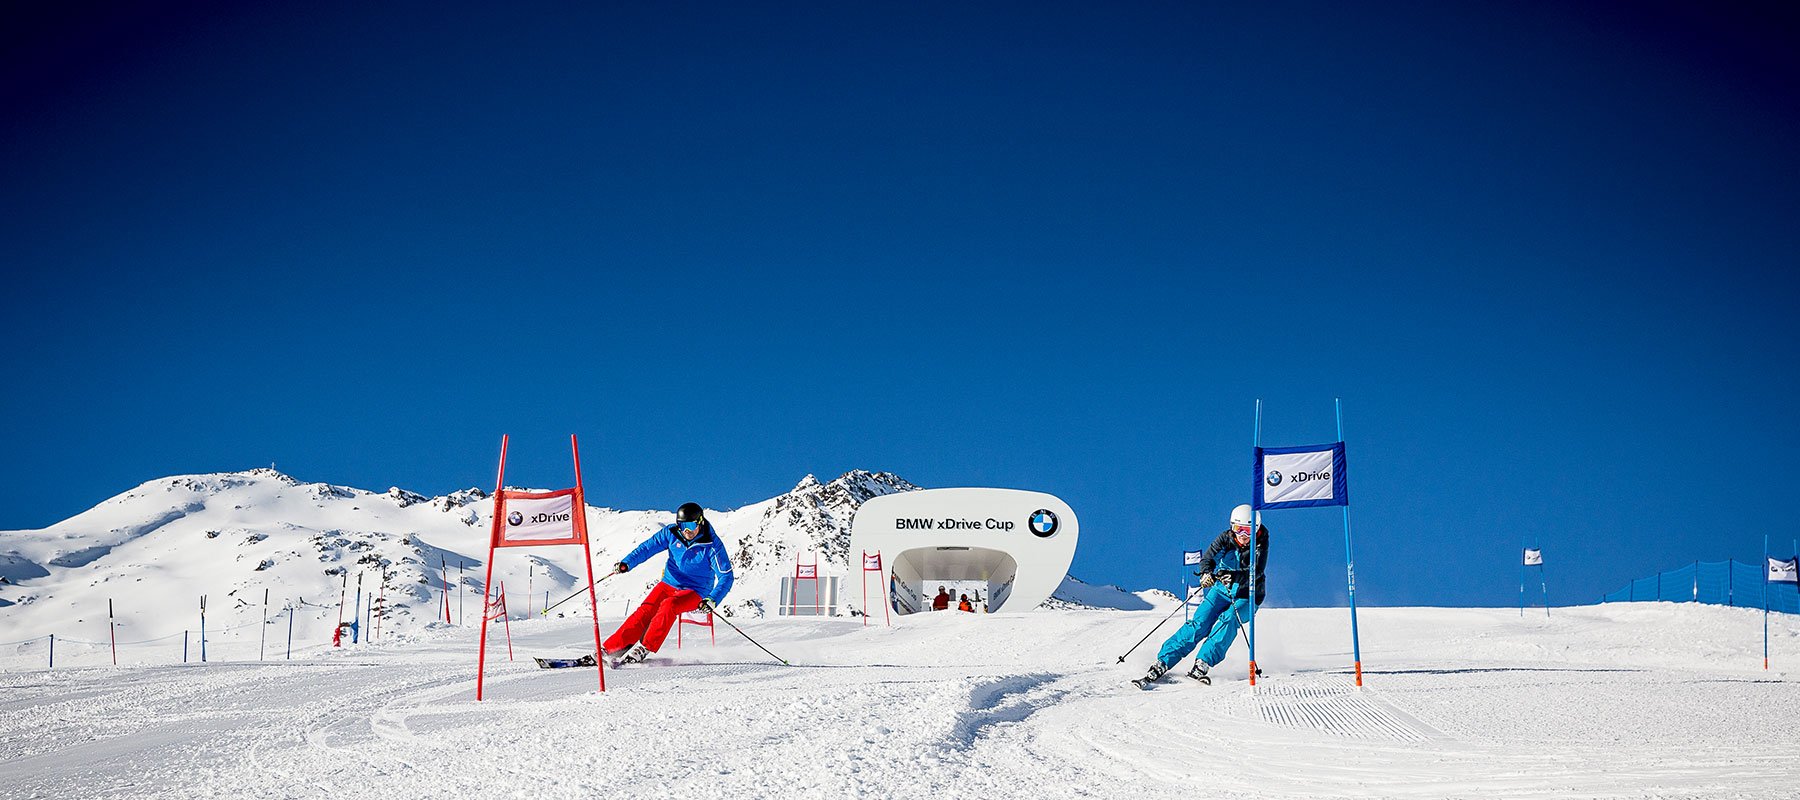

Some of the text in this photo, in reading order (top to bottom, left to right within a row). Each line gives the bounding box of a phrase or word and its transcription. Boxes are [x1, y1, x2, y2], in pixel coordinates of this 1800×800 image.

[1290, 470, 1331, 483] xDrive
[531, 512, 570, 524] xDrive
[895, 517, 1014, 532] BMW xDrive Cup
